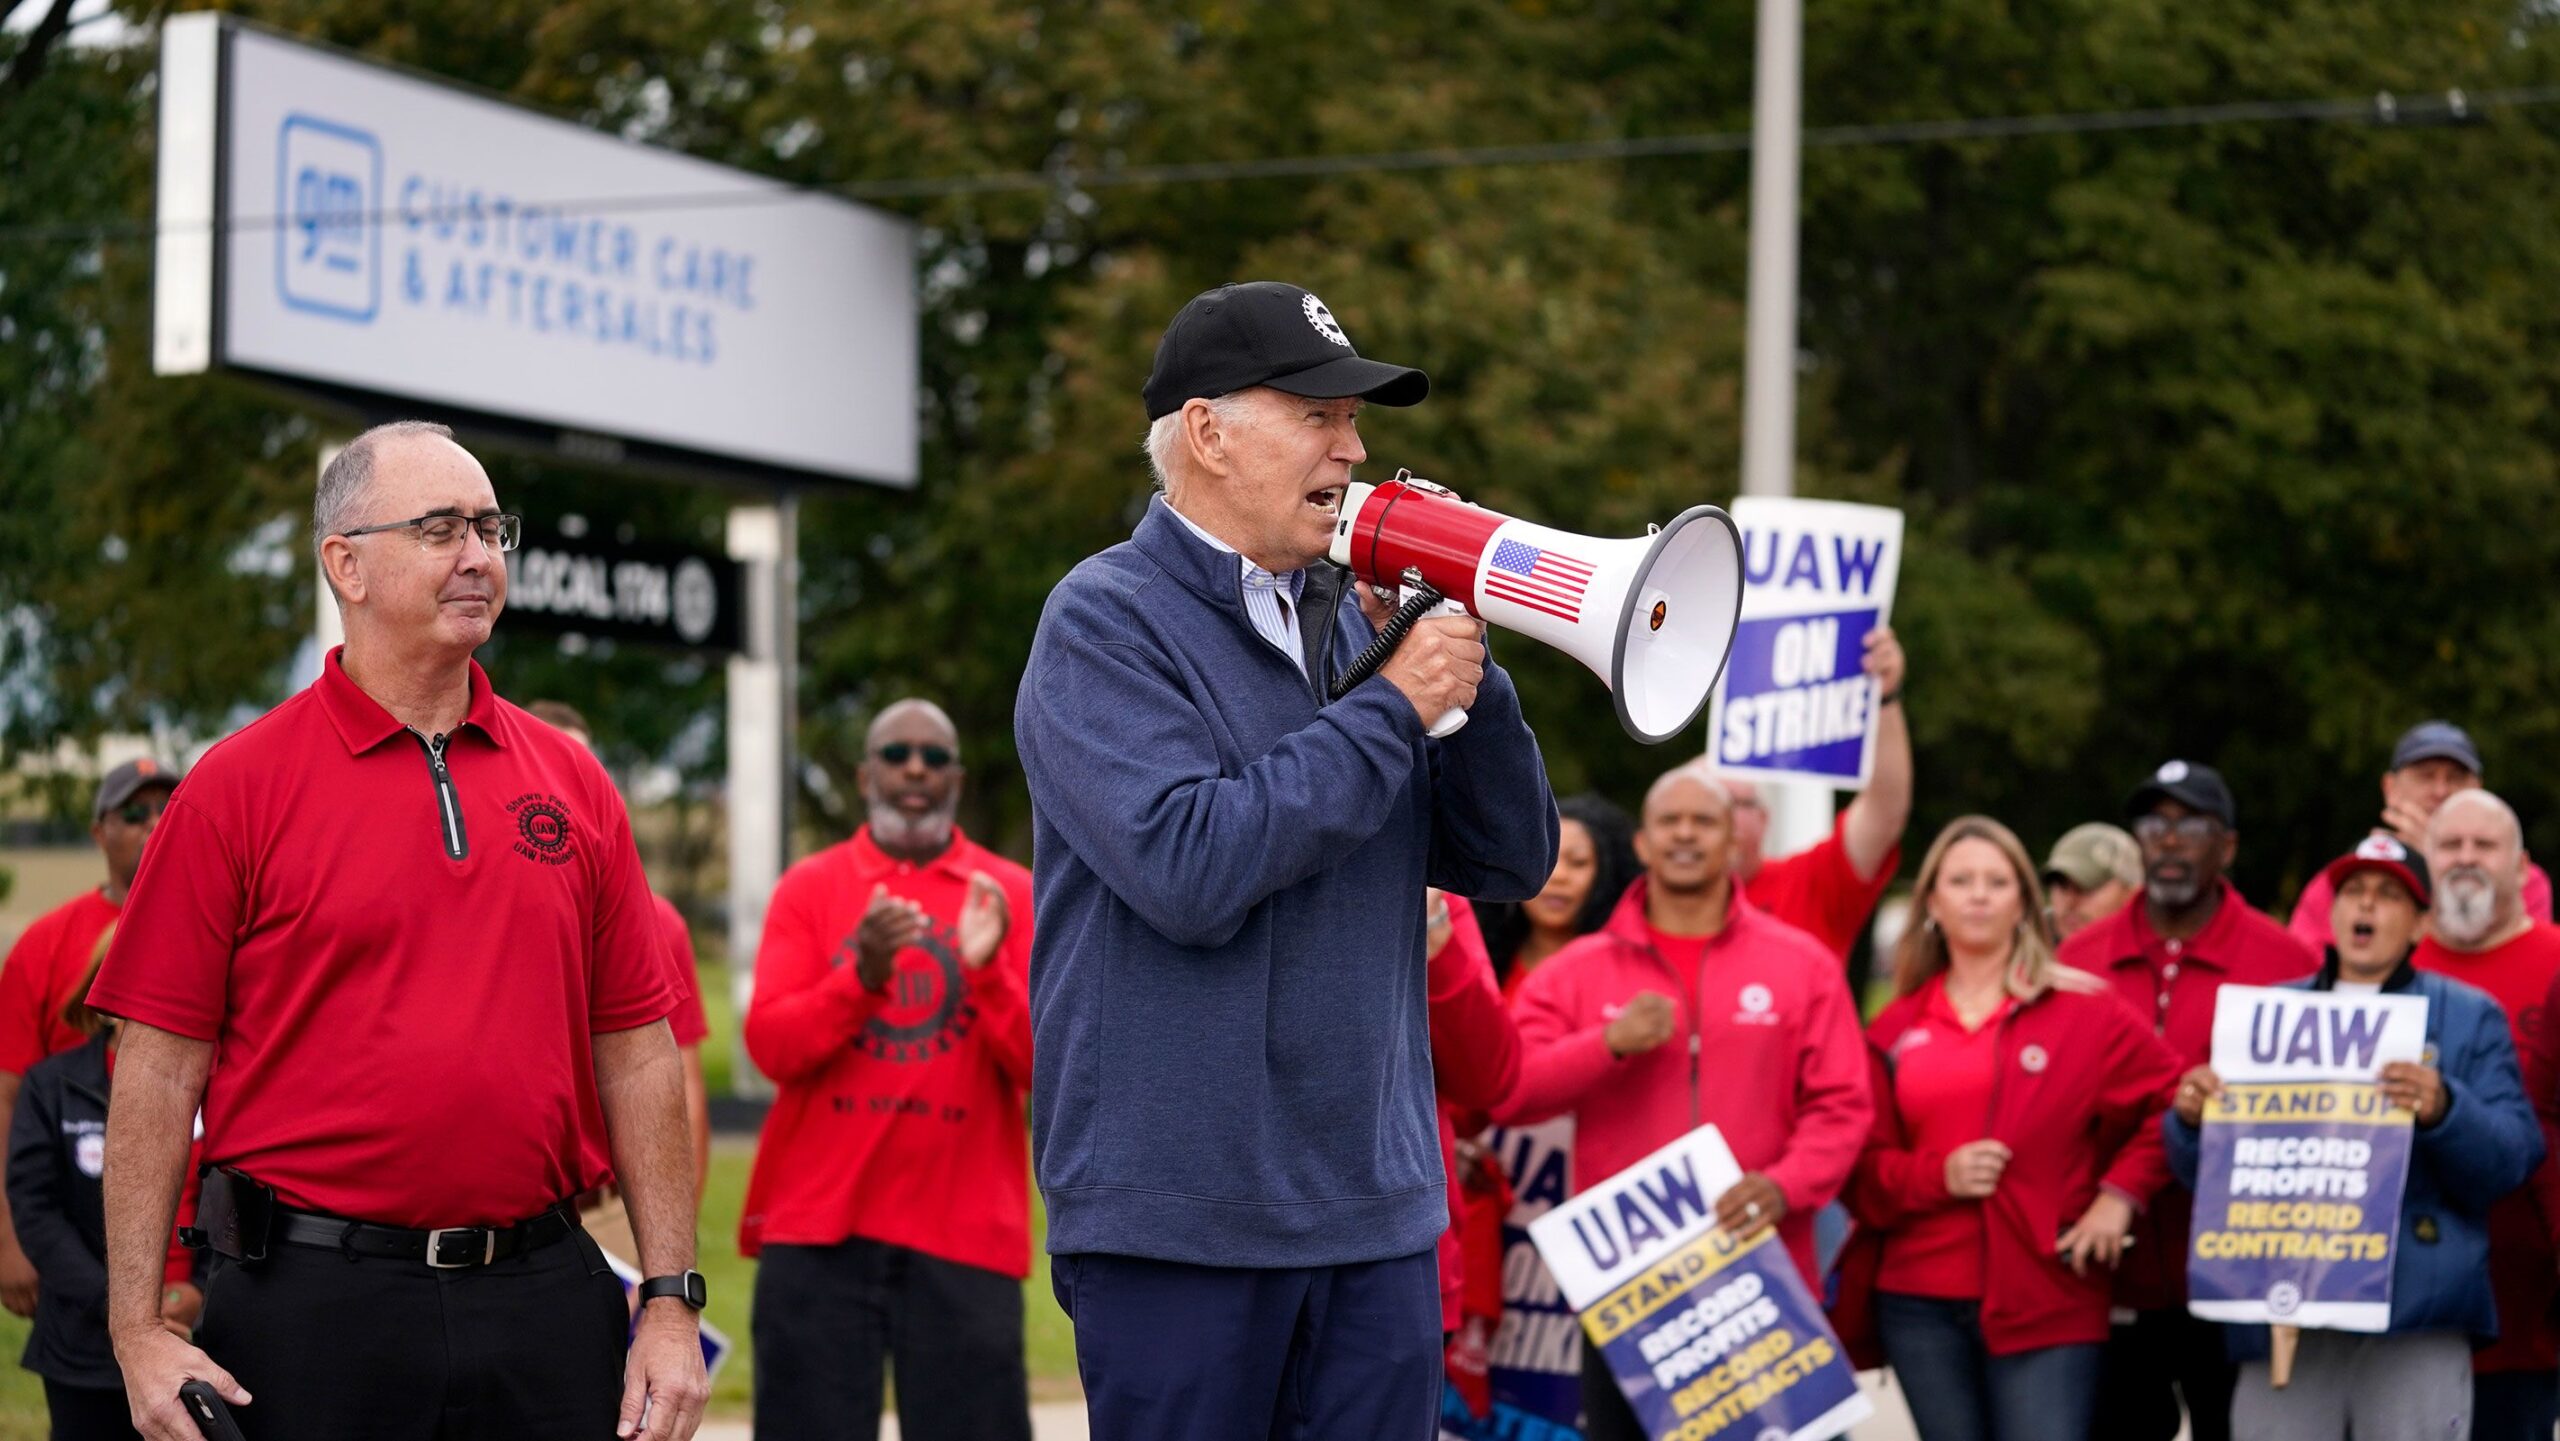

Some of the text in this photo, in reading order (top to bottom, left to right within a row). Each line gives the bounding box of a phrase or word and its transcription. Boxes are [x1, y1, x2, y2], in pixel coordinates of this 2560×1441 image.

[401, 173, 755, 310] CUSTOMER CARE
[402, 246, 716, 364] & AFTERSALES
[506, 549, 614, 620] LOCAL
[1744, 529, 1883, 595] UAW
[1771, 615, 1839, 691] ON
[1722, 674, 1869, 763] STRIKE
[513, 841, 537, 861] UAW
[532, 822, 557, 835] UAW
[2251, 1002, 2390, 1069] UAW
[2221, 1091, 2337, 1115] STAND
[2230, 1168, 2368, 1199] PROFITS
[2234, 1137, 2372, 1169] RECORD
[1571, 1154, 1707, 1271] UAW
[2195, 1231, 2389, 1261] CONTRACTS
[2226, 1201, 2363, 1231] RECORD
[1597, 1252, 1706, 1331] STAND
[1638, 1271, 1764, 1365] RECORD
[1652, 1296, 1780, 1391] PROFITS
[1671, 1329, 1794, 1418] RECORD
